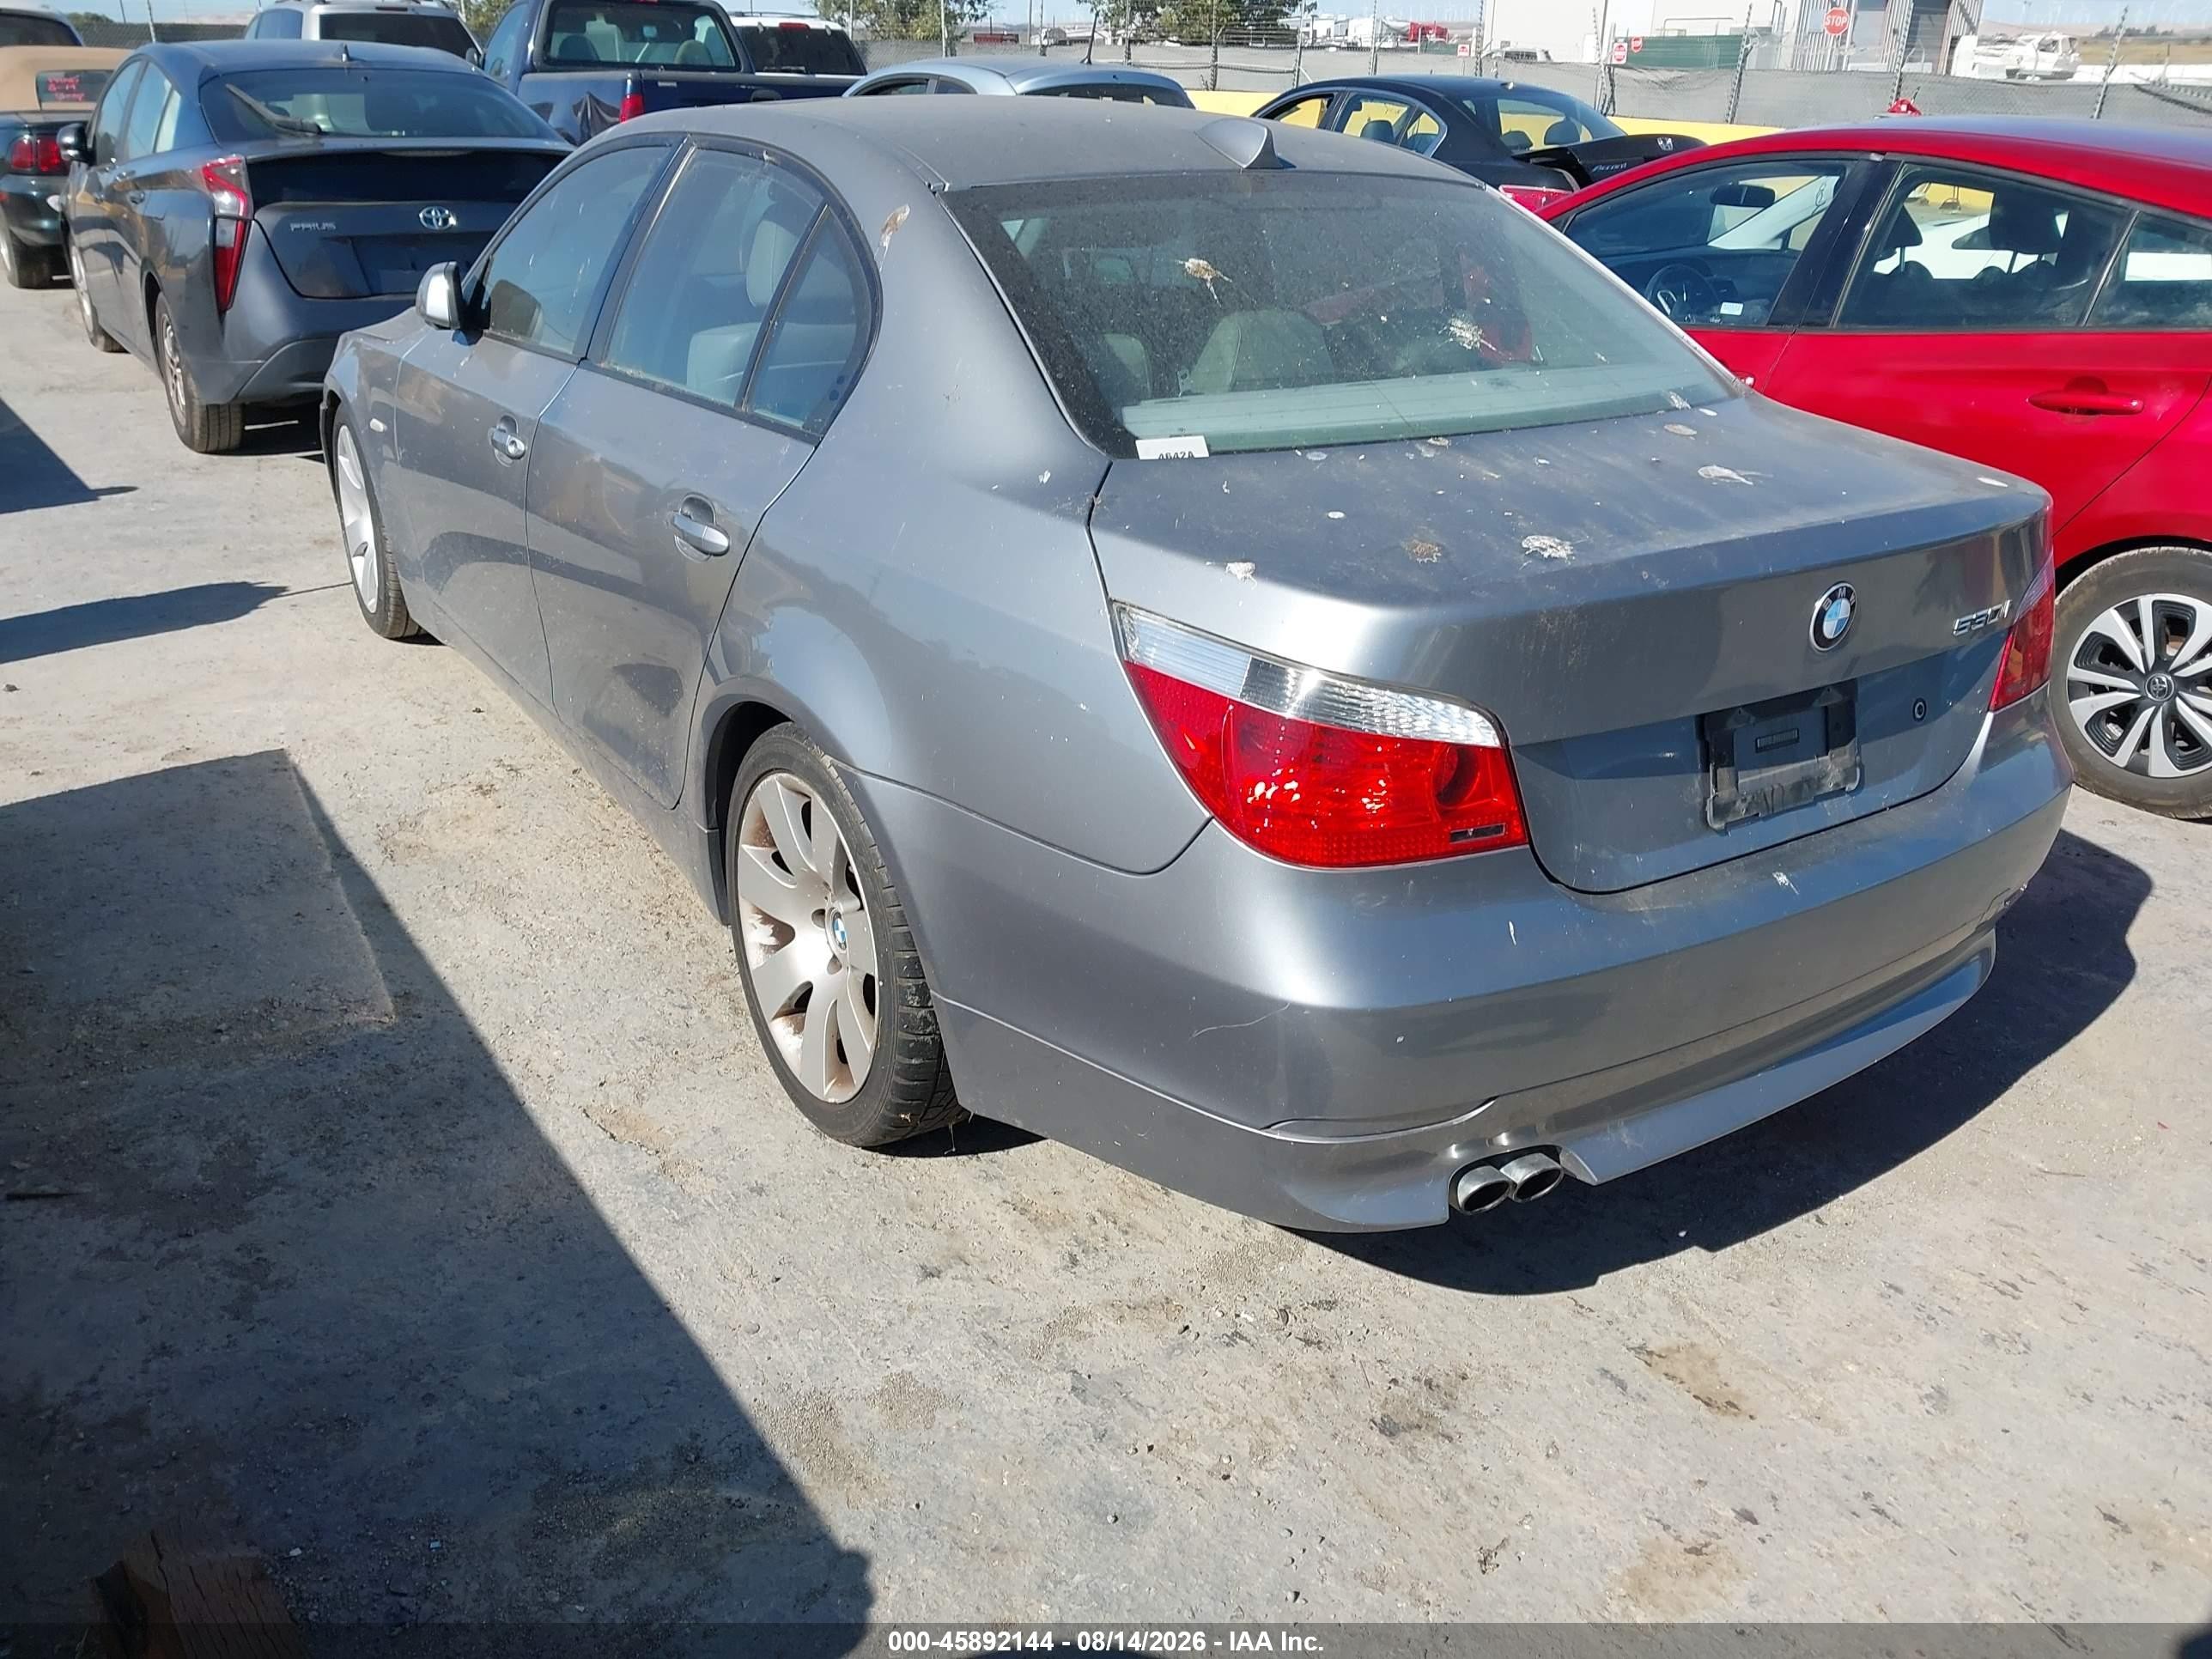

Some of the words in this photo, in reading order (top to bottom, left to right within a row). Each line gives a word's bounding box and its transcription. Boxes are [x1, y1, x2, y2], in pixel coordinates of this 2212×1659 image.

[1825, 15, 1848, 27] STOP
[1822, 586, 1856, 611] BMW
[1953, 599, 2011, 636] 530i
